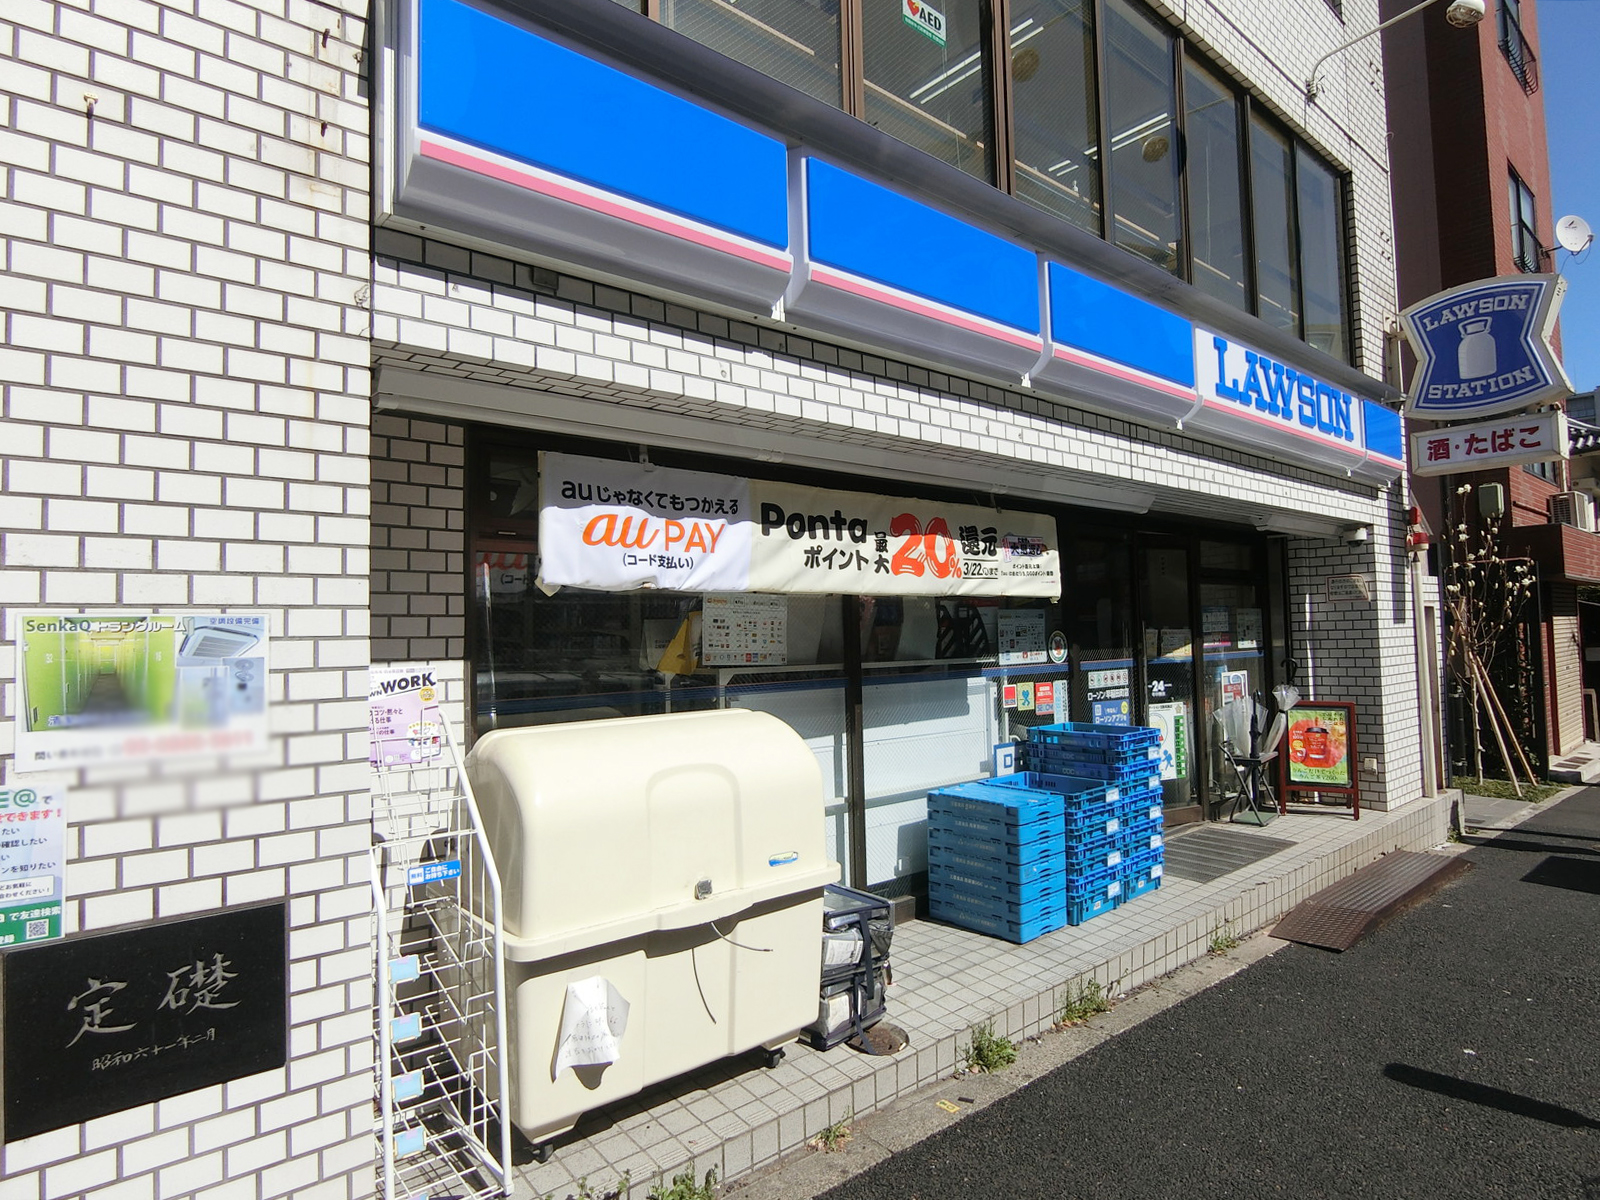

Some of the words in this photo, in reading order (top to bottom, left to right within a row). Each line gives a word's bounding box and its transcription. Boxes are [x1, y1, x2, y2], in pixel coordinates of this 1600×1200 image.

[919, 7, 942, 31] AED
[1424, 293, 1530, 333] LAWSON
[1212, 335, 1355, 442] LAWSON
[1427, 365, 1536, 400] STATION
[1426, 425, 1542, 462] 酒・たばこ
[581, 513, 660, 550] au
[664, 519, 726, 554] PAY
[760, 502, 869, 544] Ponta
[959, 525, 998, 557] 還元
[803, 545, 870, 571] ポイント
[26, 619, 92, 634] SenkaQ
[380, 672, 437, 694] WORK
[1152, 680, 1165, 692] 24
[0, 808, 62, 823] できます！
[0, 837, 48, 848] 確認したい
